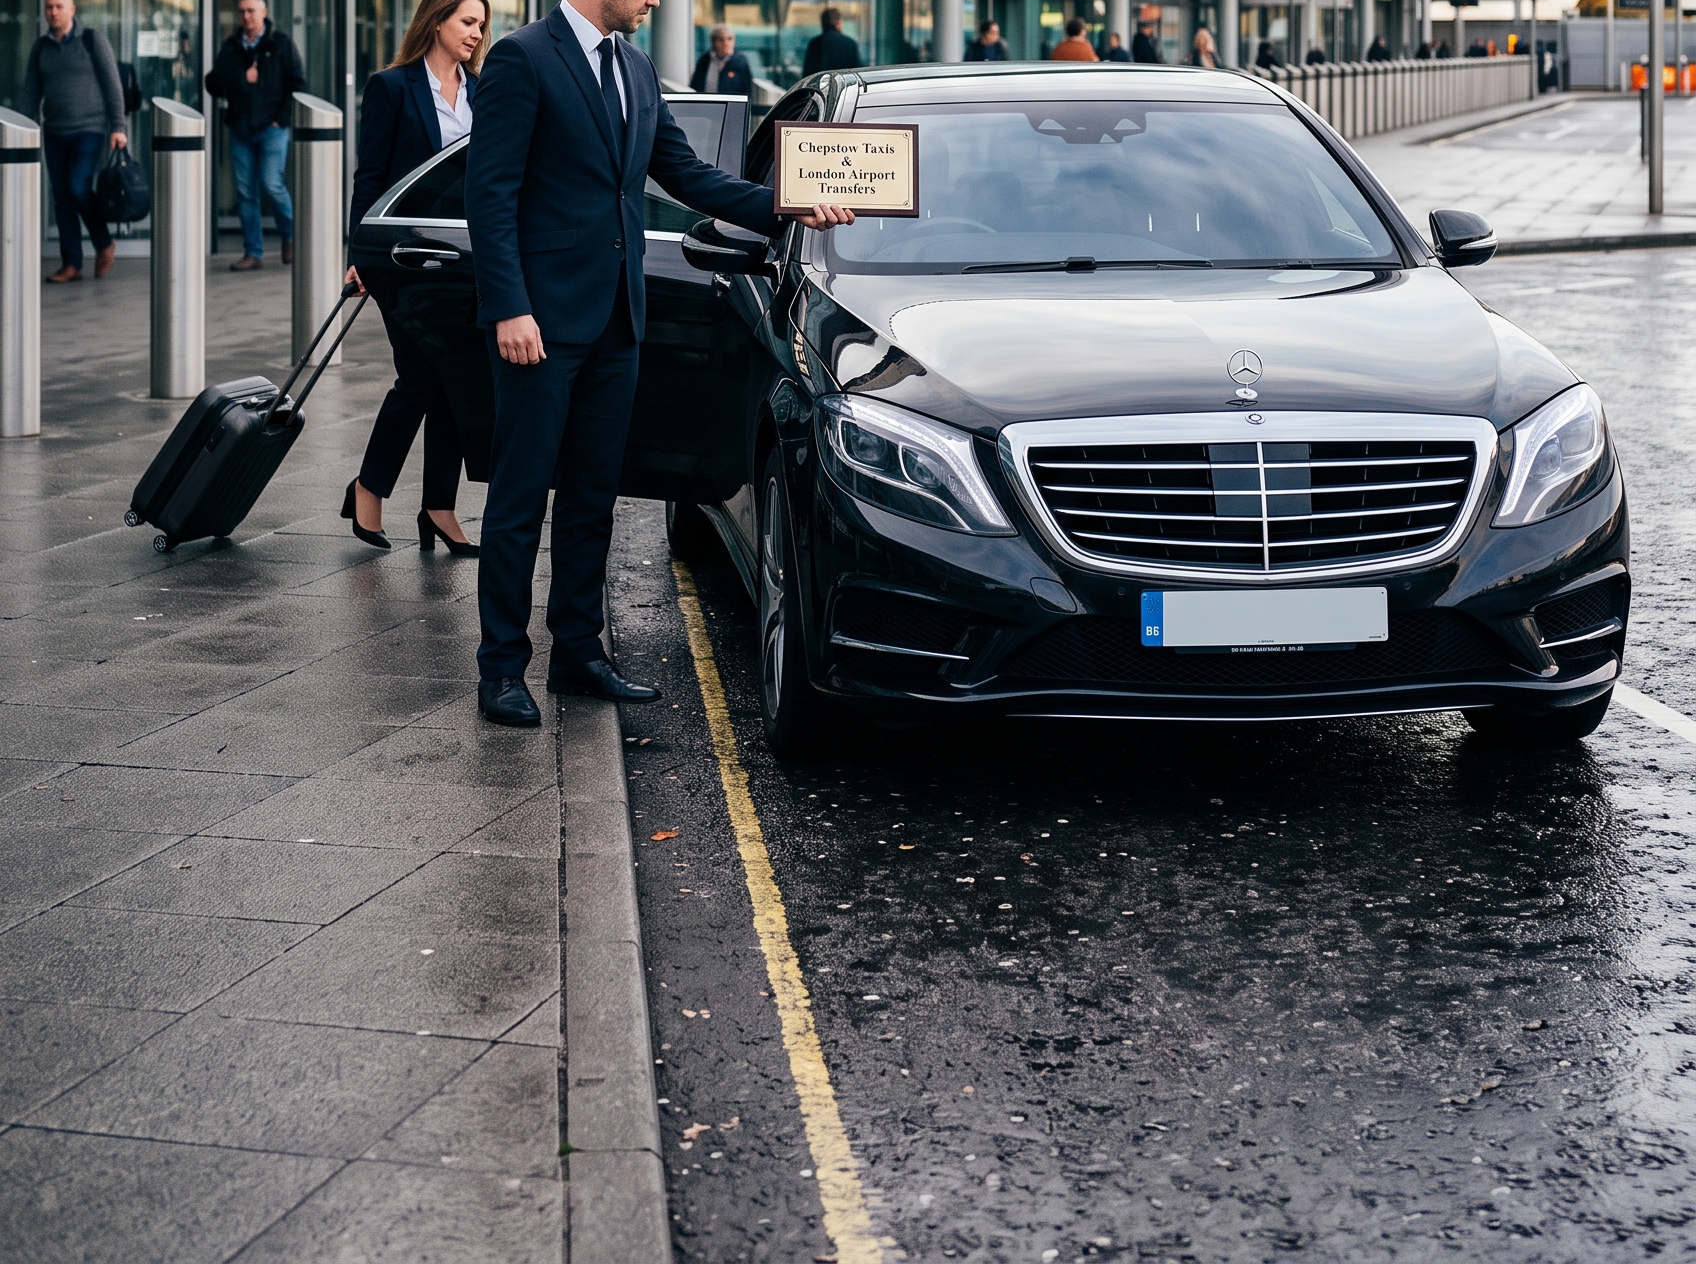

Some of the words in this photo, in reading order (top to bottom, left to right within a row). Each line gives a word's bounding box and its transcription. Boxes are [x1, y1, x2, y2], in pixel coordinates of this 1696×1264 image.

[798, 142, 858, 155] Chepstow
[862, 143, 895, 154] Taxis
[841, 156, 852, 167] &
[798, 168, 845, 180] London
[848, 169, 896, 182] Airport
[818, 183, 876, 194] Transfers
